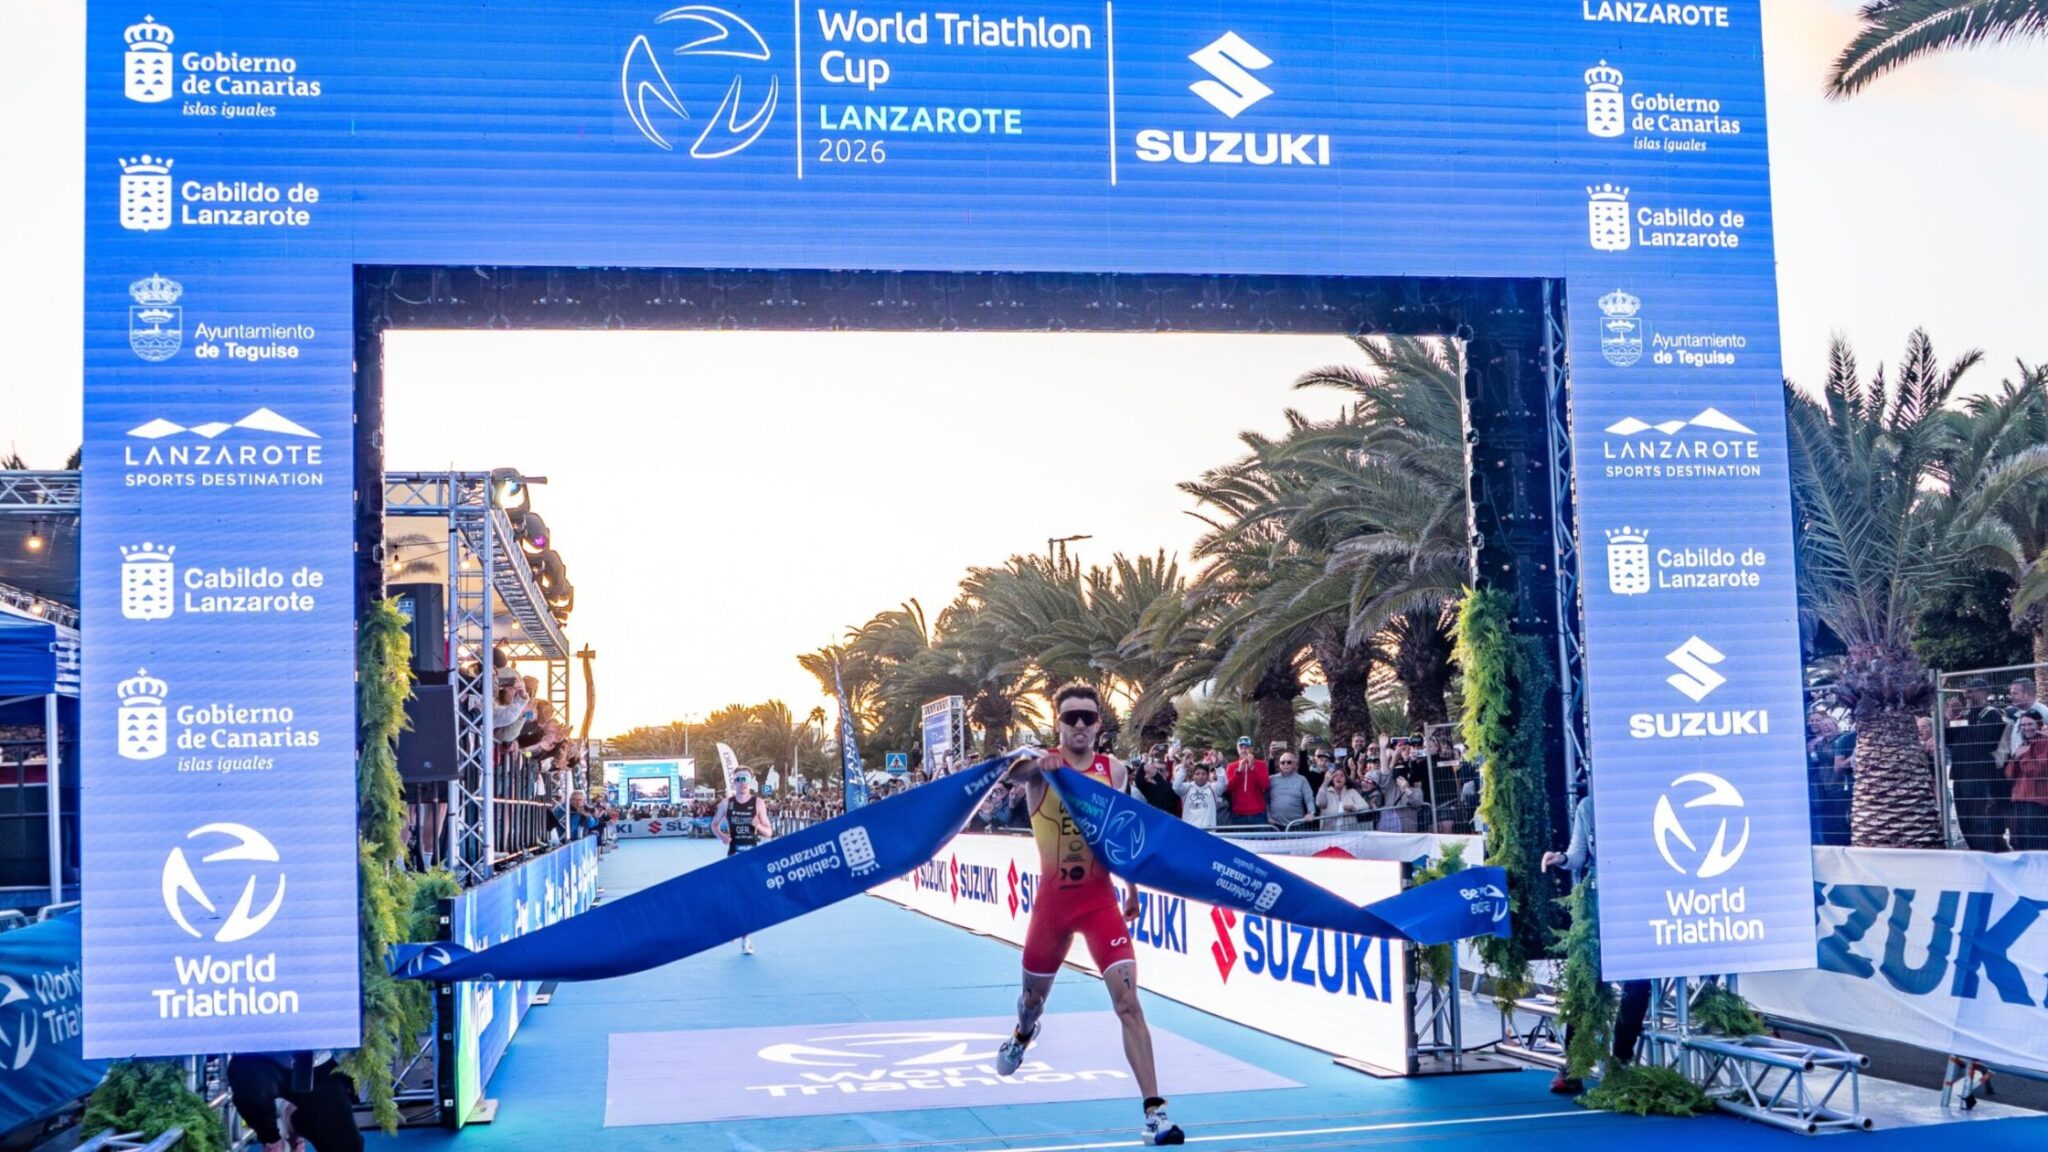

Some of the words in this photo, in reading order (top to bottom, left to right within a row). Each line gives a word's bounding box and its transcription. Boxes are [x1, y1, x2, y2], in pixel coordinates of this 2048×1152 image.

[1582, 0, 1730, 27] LANZAROTE
[818, 9, 929, 45] World
[935, 13, 1092, 50] Triathlon
[182, 51, 296, 73] Gobierno
[819, 50, 890, 91] Cup
[182, 76, 210, 96] de
[215, 76, 321, 97] Canarias
[182, 101, 218, 117] islas
[221, 103, 277, 120] iguales
[1631, 92, 1720, 114] Gobierno
[819, 105, 1022, 135] LANZAROTE
[1632, 114, 1655, 132] de
[1658, 114, 1740, 135] Canarias
[819, 139, 886, 164] 2026
[1135, 129, 1330, 166] SUZUKI
[1632, 137, 1660, 151] islas
[1663, 138, 1707, 153] iguales
[182, 181, 280, 203] Cabildo
[287, 183, 319, 203] de
[182, 204, 310, 227] Lanzarote
[1637, 207, 1713, 228] Cabildo
[1720, 209, 1745, 228] de
[1639, 228, 1739, 248] Lanzarote
[194, 322, 315, 341] Ayuntamiento
[1652, 333, 1746, 349] Ayuntamiento
[195, 343, 220, 359] de
[225, 343, 299, 362] Teguise
[1653, 350, 1673, 365] de
[1677, 350, 1735, 367] Teguise
[125, 445, 322, 466] LANZAROTE
[1604, 440, 1759, 459] LANZAROTE
[125, 473, 195, 487] SPORTS
[201, 472, 324, 486] DESTINATION
[1606, 465, 1662, 478] SPORTS
[1666, 464, 1761, 477] DESTINATION
[1657, 547, 1736, 569] Cabildo
[1741, 546, 1766, 567] de
[184, 567, 283, 589] Cabildo
[292, 567, 323, 589] de
[1658, 568, 1761, 589] Lanzarote
[184, 591, 315, 613] Lanzarote
[177, 703, 294, 726] Gobierno
[1629, 710, 1769, 739] SUZUKI
[177, 728, 207, 750] de
[211, 727, 320, 749] Canarias
[177, 756, 213, 772] islas
[217, 756, 274, 774] iguales
[736, 826, 750, 834] GER
[766, 839, 837, 874] Lanzarote
[788, 855, 841, 883] Cabildo
[921, 859, 947, 893] SUZUKI
[1211, 861, 1252, 887] Canarias
[766, 878, 785, 890] de
[960, 863, 999, 905] SUZUKI
[1215, 877, 1256, 902] Gobierno
[1250, 878, 1263, 892] de
[1666, 887, 1746, 916] World
[1113, 886, 1187, 955] ZUKI
[1649, 916, 1765, 945] Triathlon
[1815, 881, 2048, 1009] ZUK
[174, 953, 276, 985] World
[1243, 914, 1392, 1004] SUZUKI
[152, 988, 299, 1019] Triathlon
[745, 1069, 1131, 1097] Triathlon
[801, 1060, 1055, 1083] World
